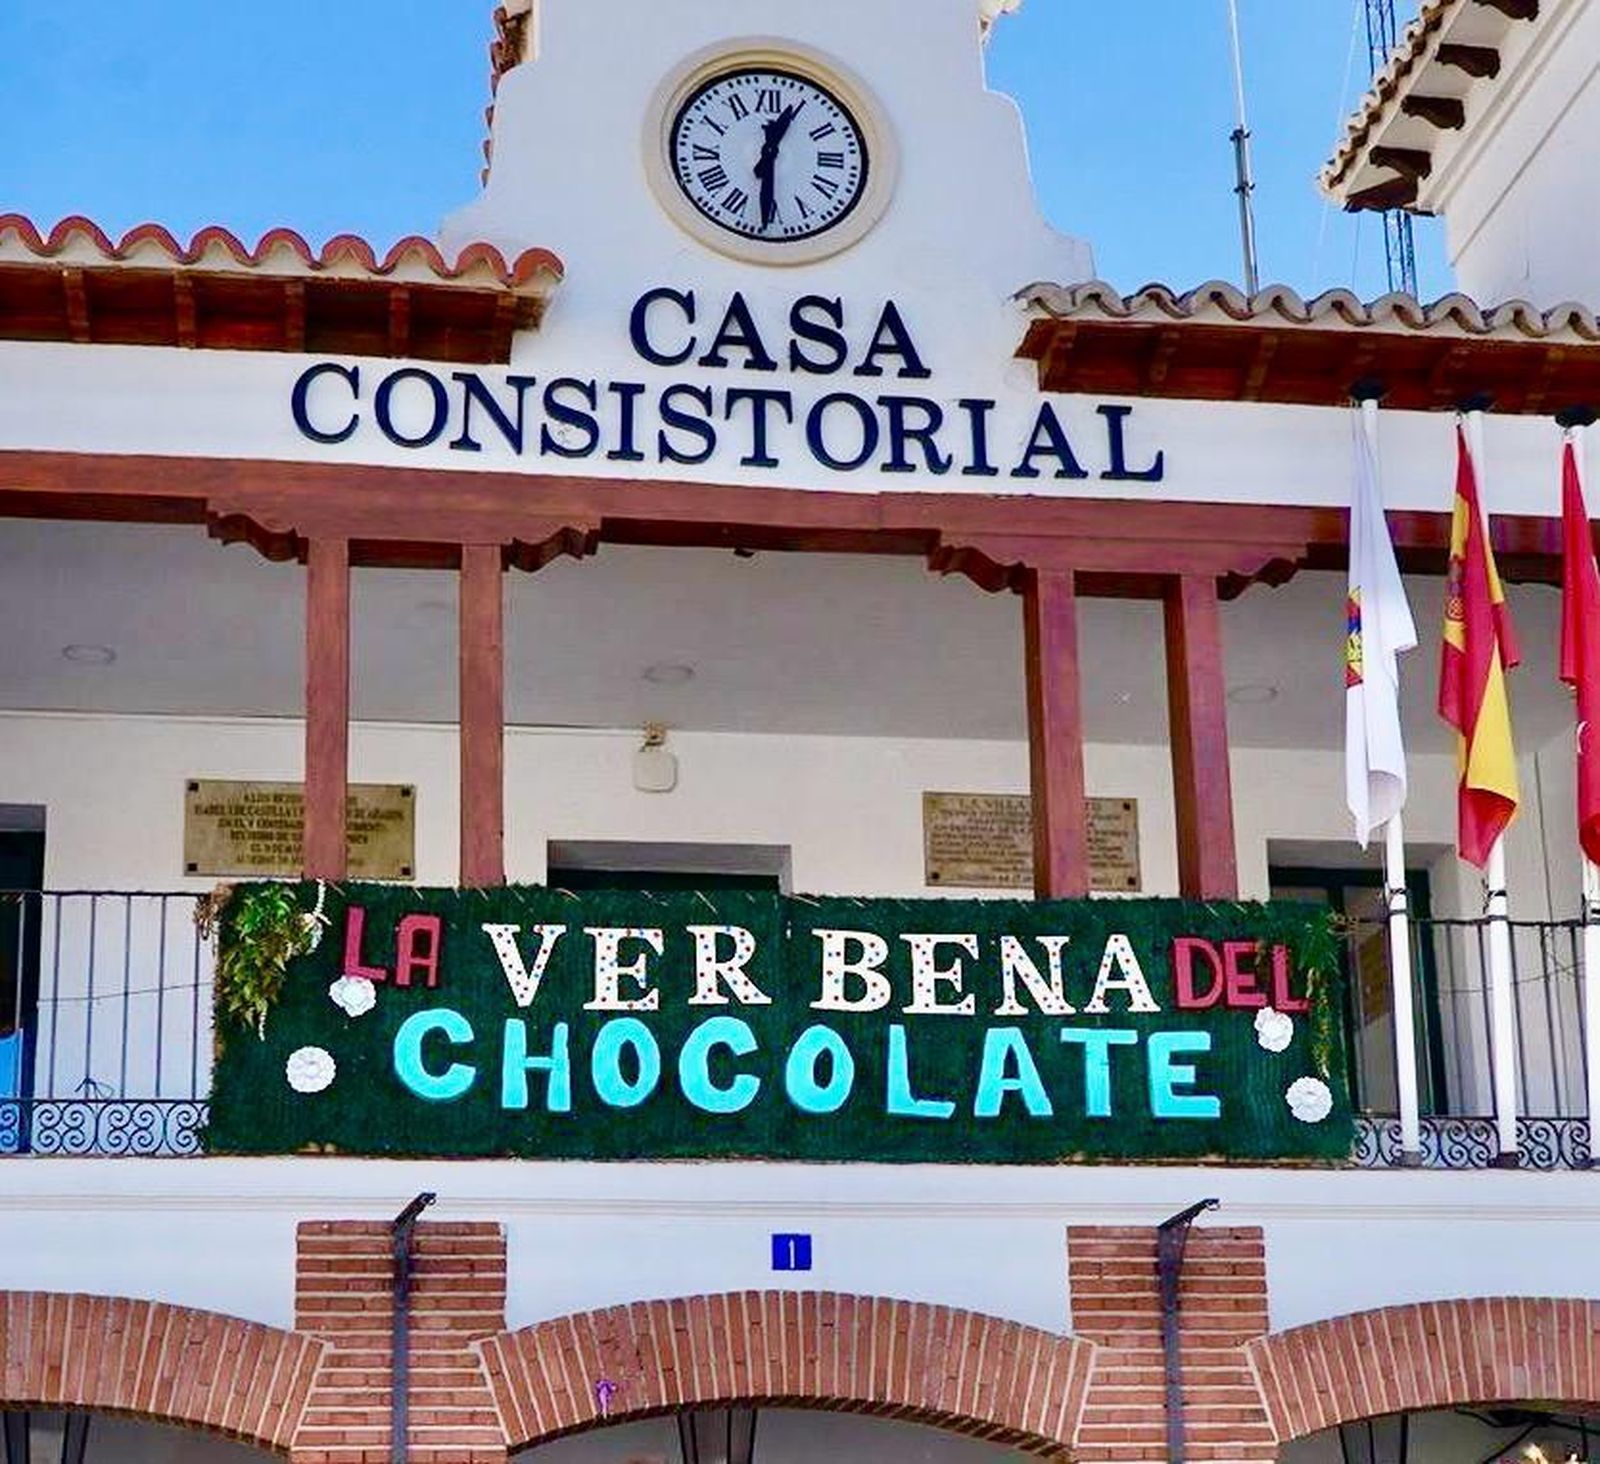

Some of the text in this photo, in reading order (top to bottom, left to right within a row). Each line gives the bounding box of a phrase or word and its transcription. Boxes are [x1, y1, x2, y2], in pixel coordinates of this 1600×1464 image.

[755, 89, 782, 114] XII
[809, 121, 837, 142] II
[691, 143, 720, 161] IX
[816, 151, 845, 169] III
[629, 287, 932, 379] CASA
[291, 362, 1164, 482] CONSISTORIAL
[342, 905, 441, 987] LA
[1171, 936, 1311, 1013] DEL
[394, 1008, 1221, 1118] CHOCOLATE
[787, 1237, 796, 1269] 1
